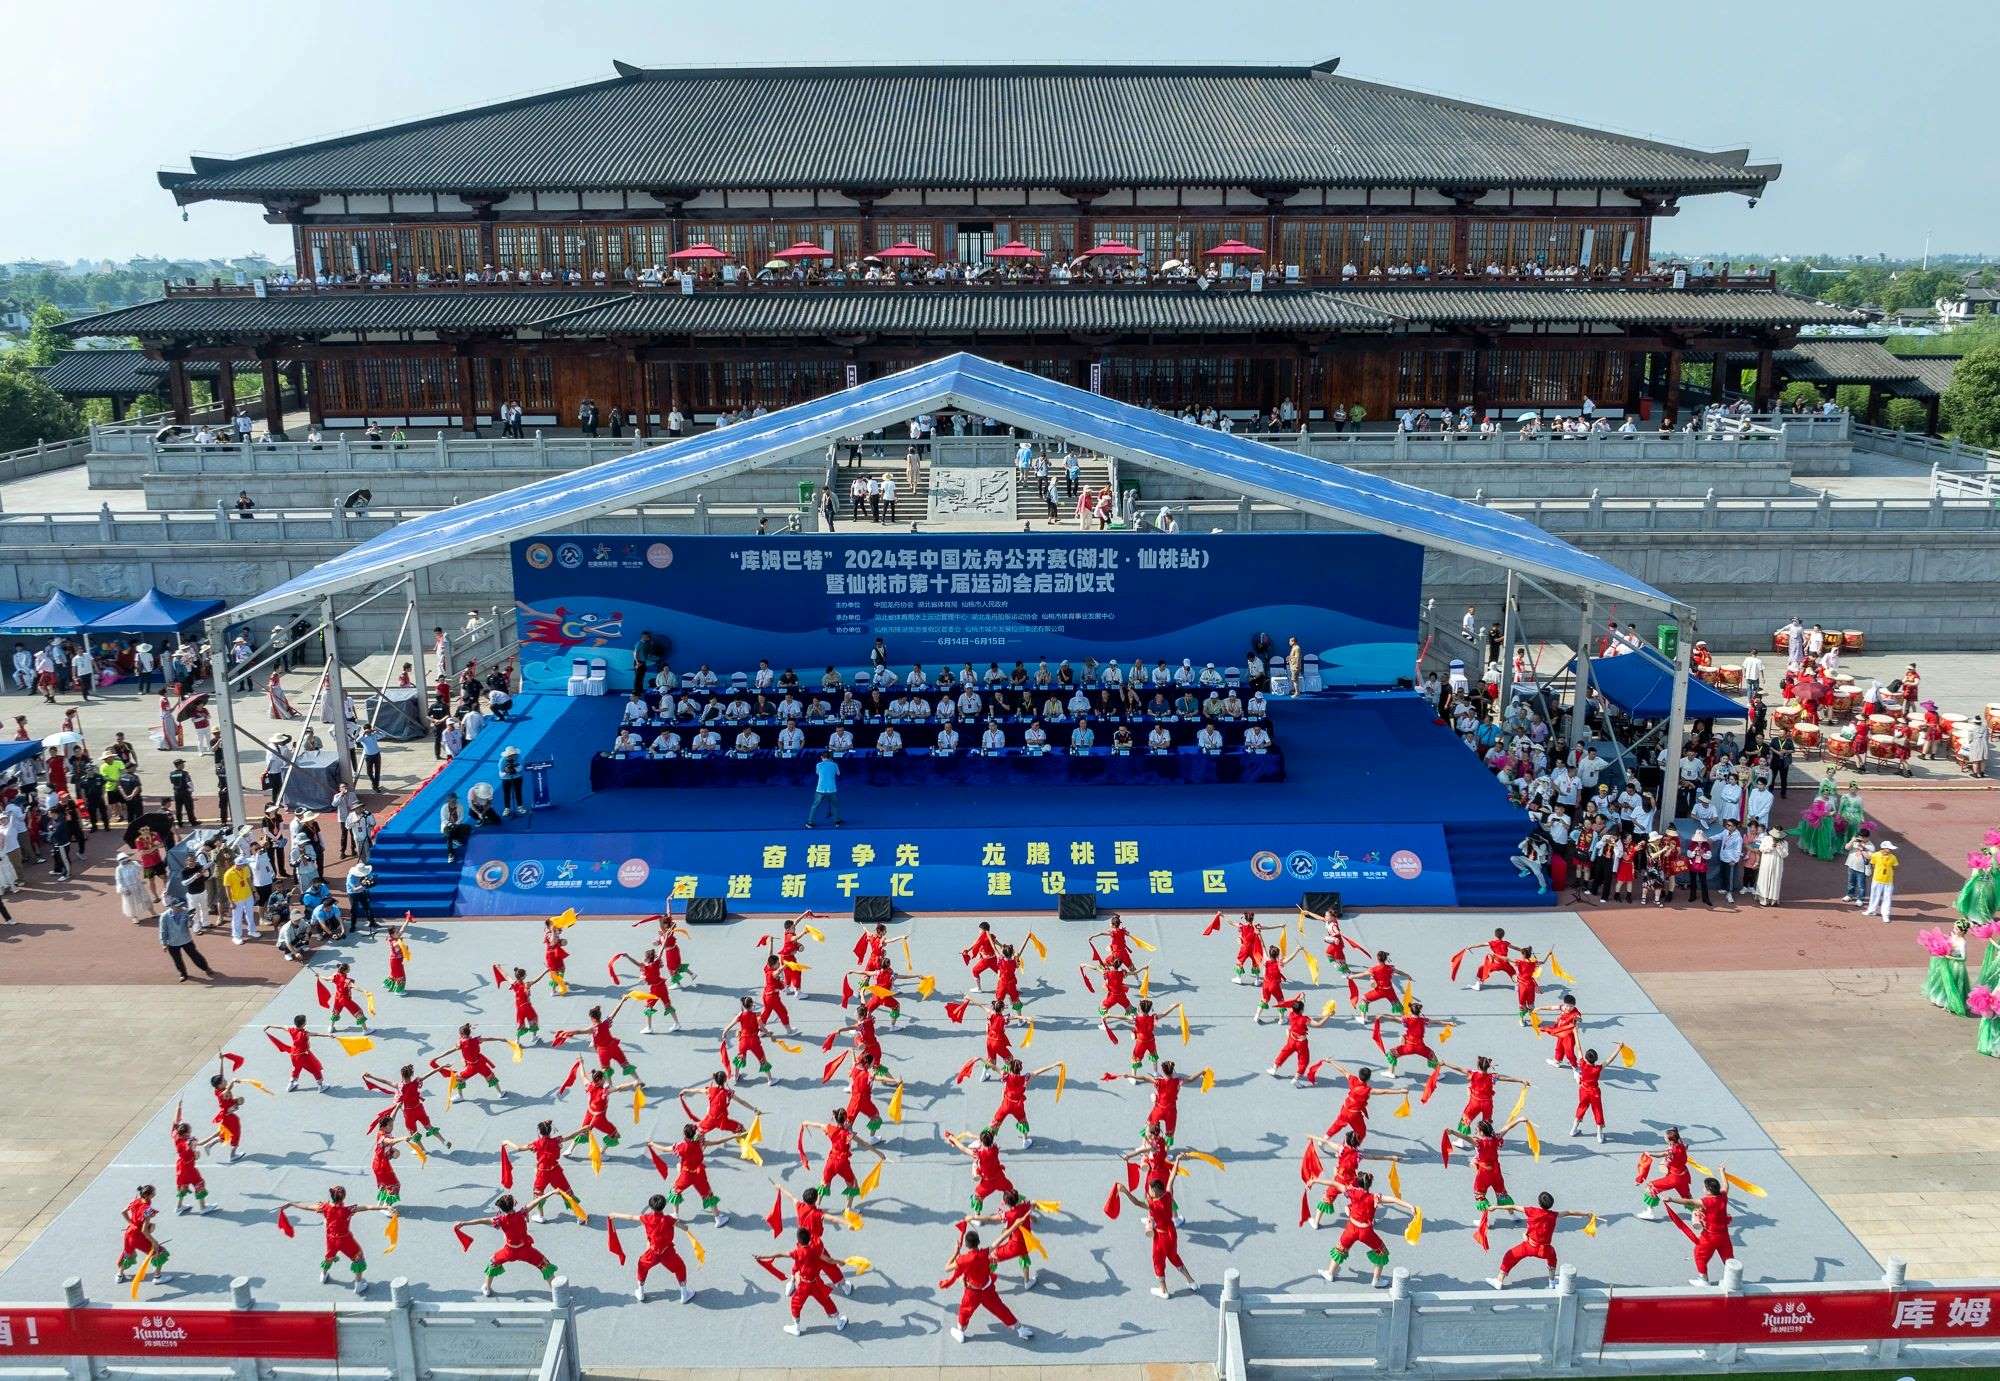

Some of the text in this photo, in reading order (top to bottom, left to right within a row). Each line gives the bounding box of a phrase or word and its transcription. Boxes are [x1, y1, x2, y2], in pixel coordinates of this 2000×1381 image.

[826, 573, 1115, 594] 暨仙桃市第十届运动会启动仪式
[763, 841, 1139, 869] 奋楫争先 龙腾桃源
[673, 873, 914, 899] 奋进新千亿
[987, 870, 1228, 896] 建设示范区
[1892, 1297, 1992, 1330] 库姆
